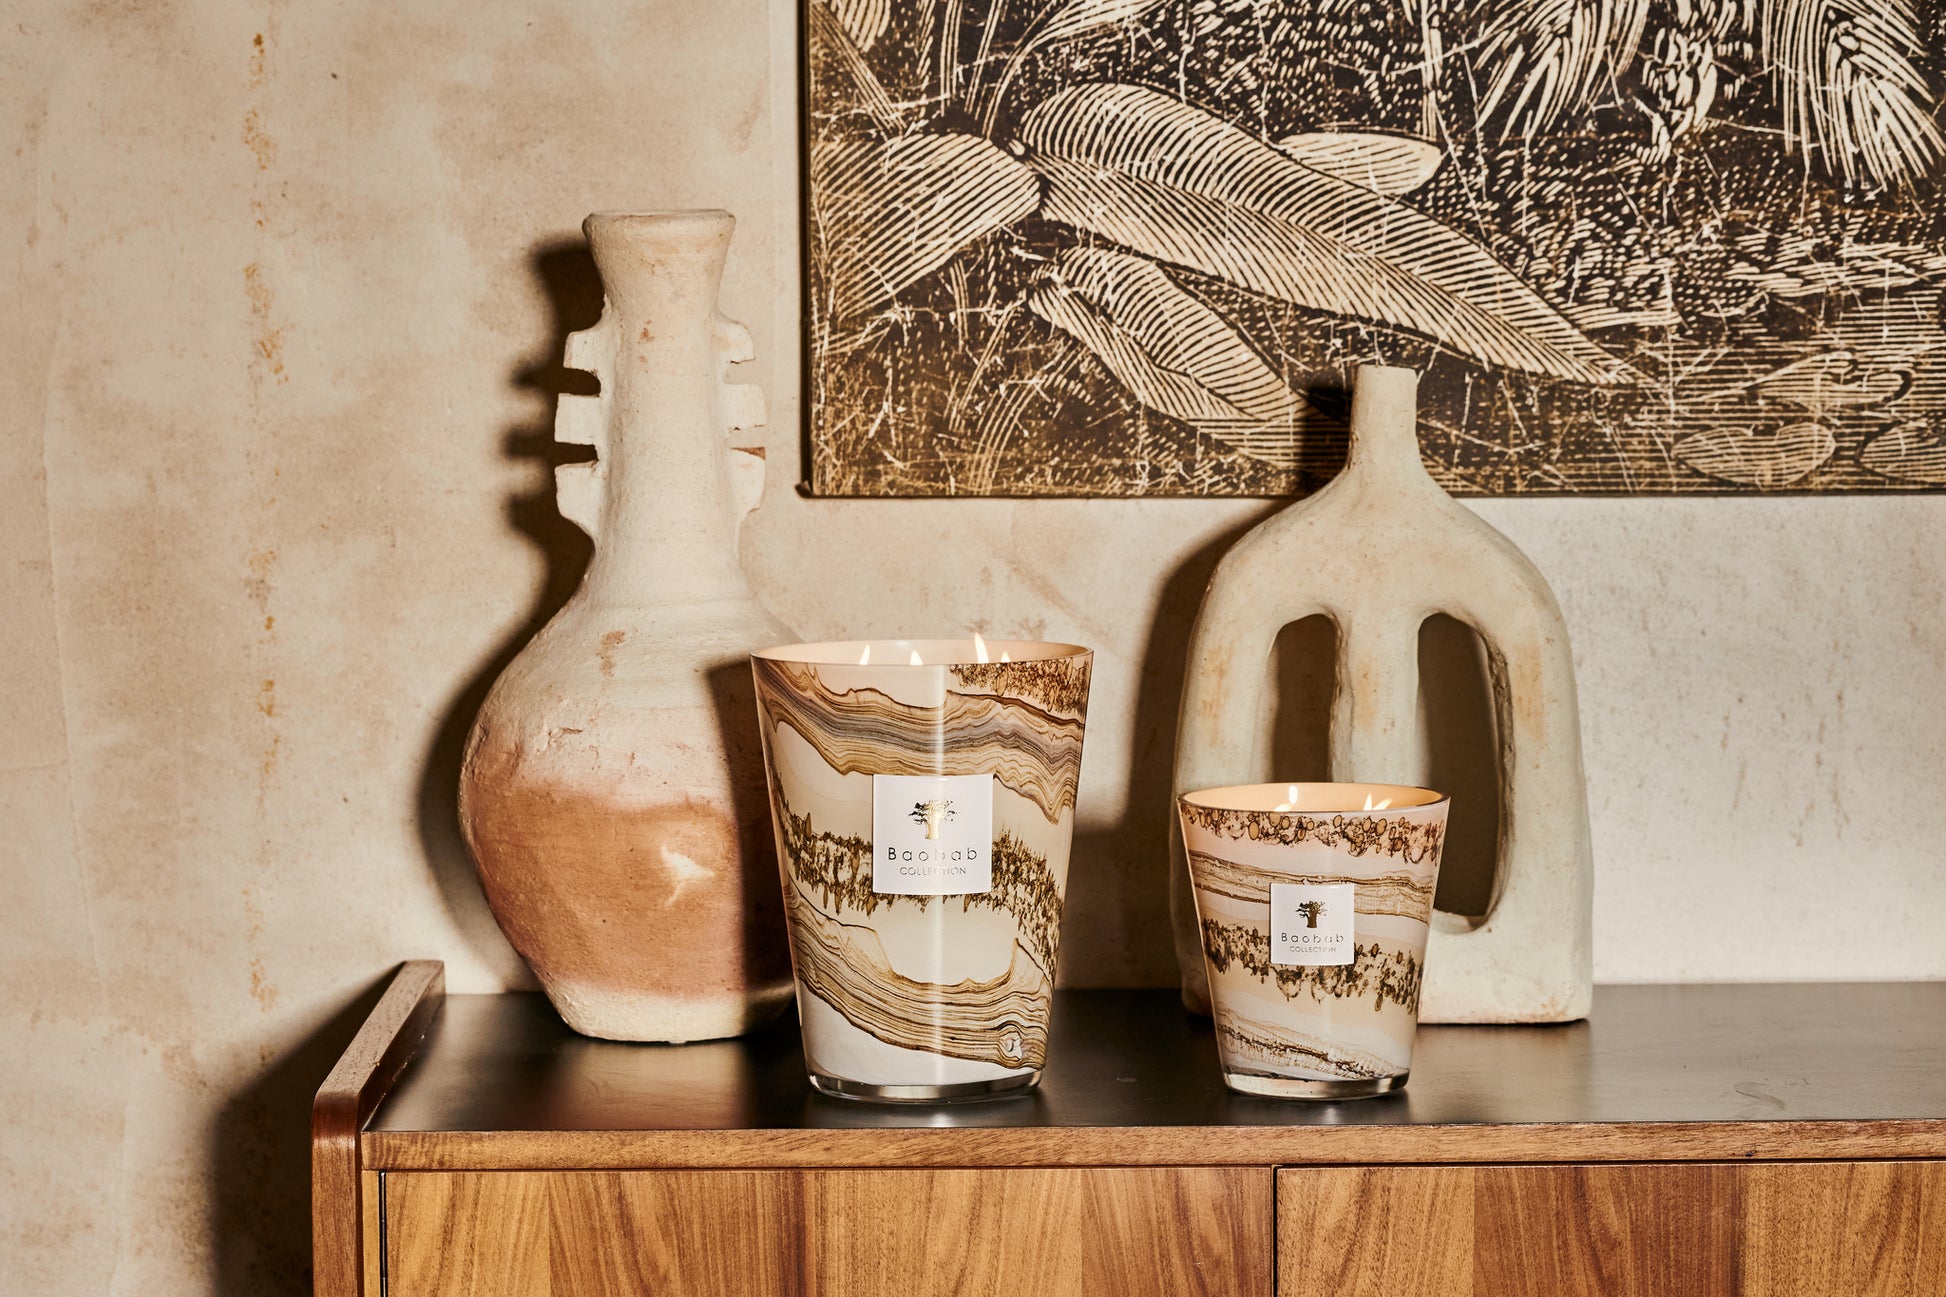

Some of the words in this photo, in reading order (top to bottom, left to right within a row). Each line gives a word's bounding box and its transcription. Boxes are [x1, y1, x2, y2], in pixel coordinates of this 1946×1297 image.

[888, 847, 978, 861] Baobab
[899, 866, 967, 876] COLLECTION
[1281, 932, 1344, 944] Baobab
